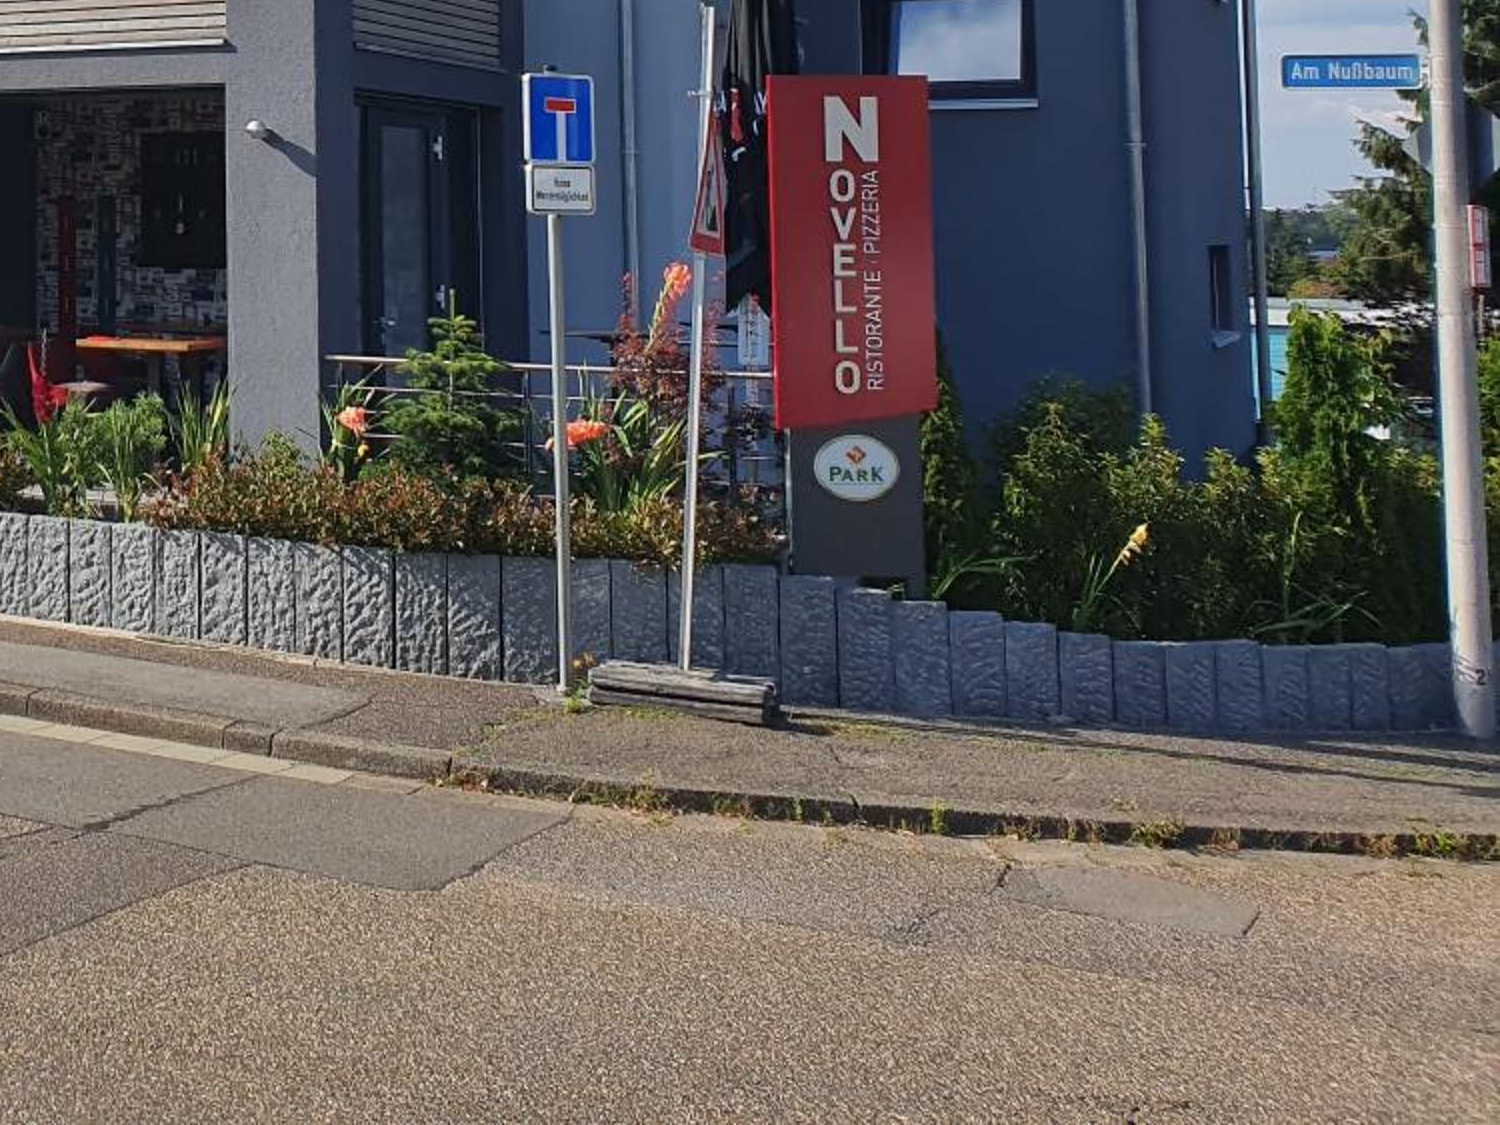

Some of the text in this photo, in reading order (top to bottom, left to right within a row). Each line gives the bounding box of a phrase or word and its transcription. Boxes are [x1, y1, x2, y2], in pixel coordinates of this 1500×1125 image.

[1291, 62, 1413, 80] Am Nußbaum
[823, 95, 879, 395] NOVELLO
[861, 170, 880, 254] PIZZERIA
[863, 270, 885, 391] RISTORANTE
[829, 466, 884, 482] PARK
